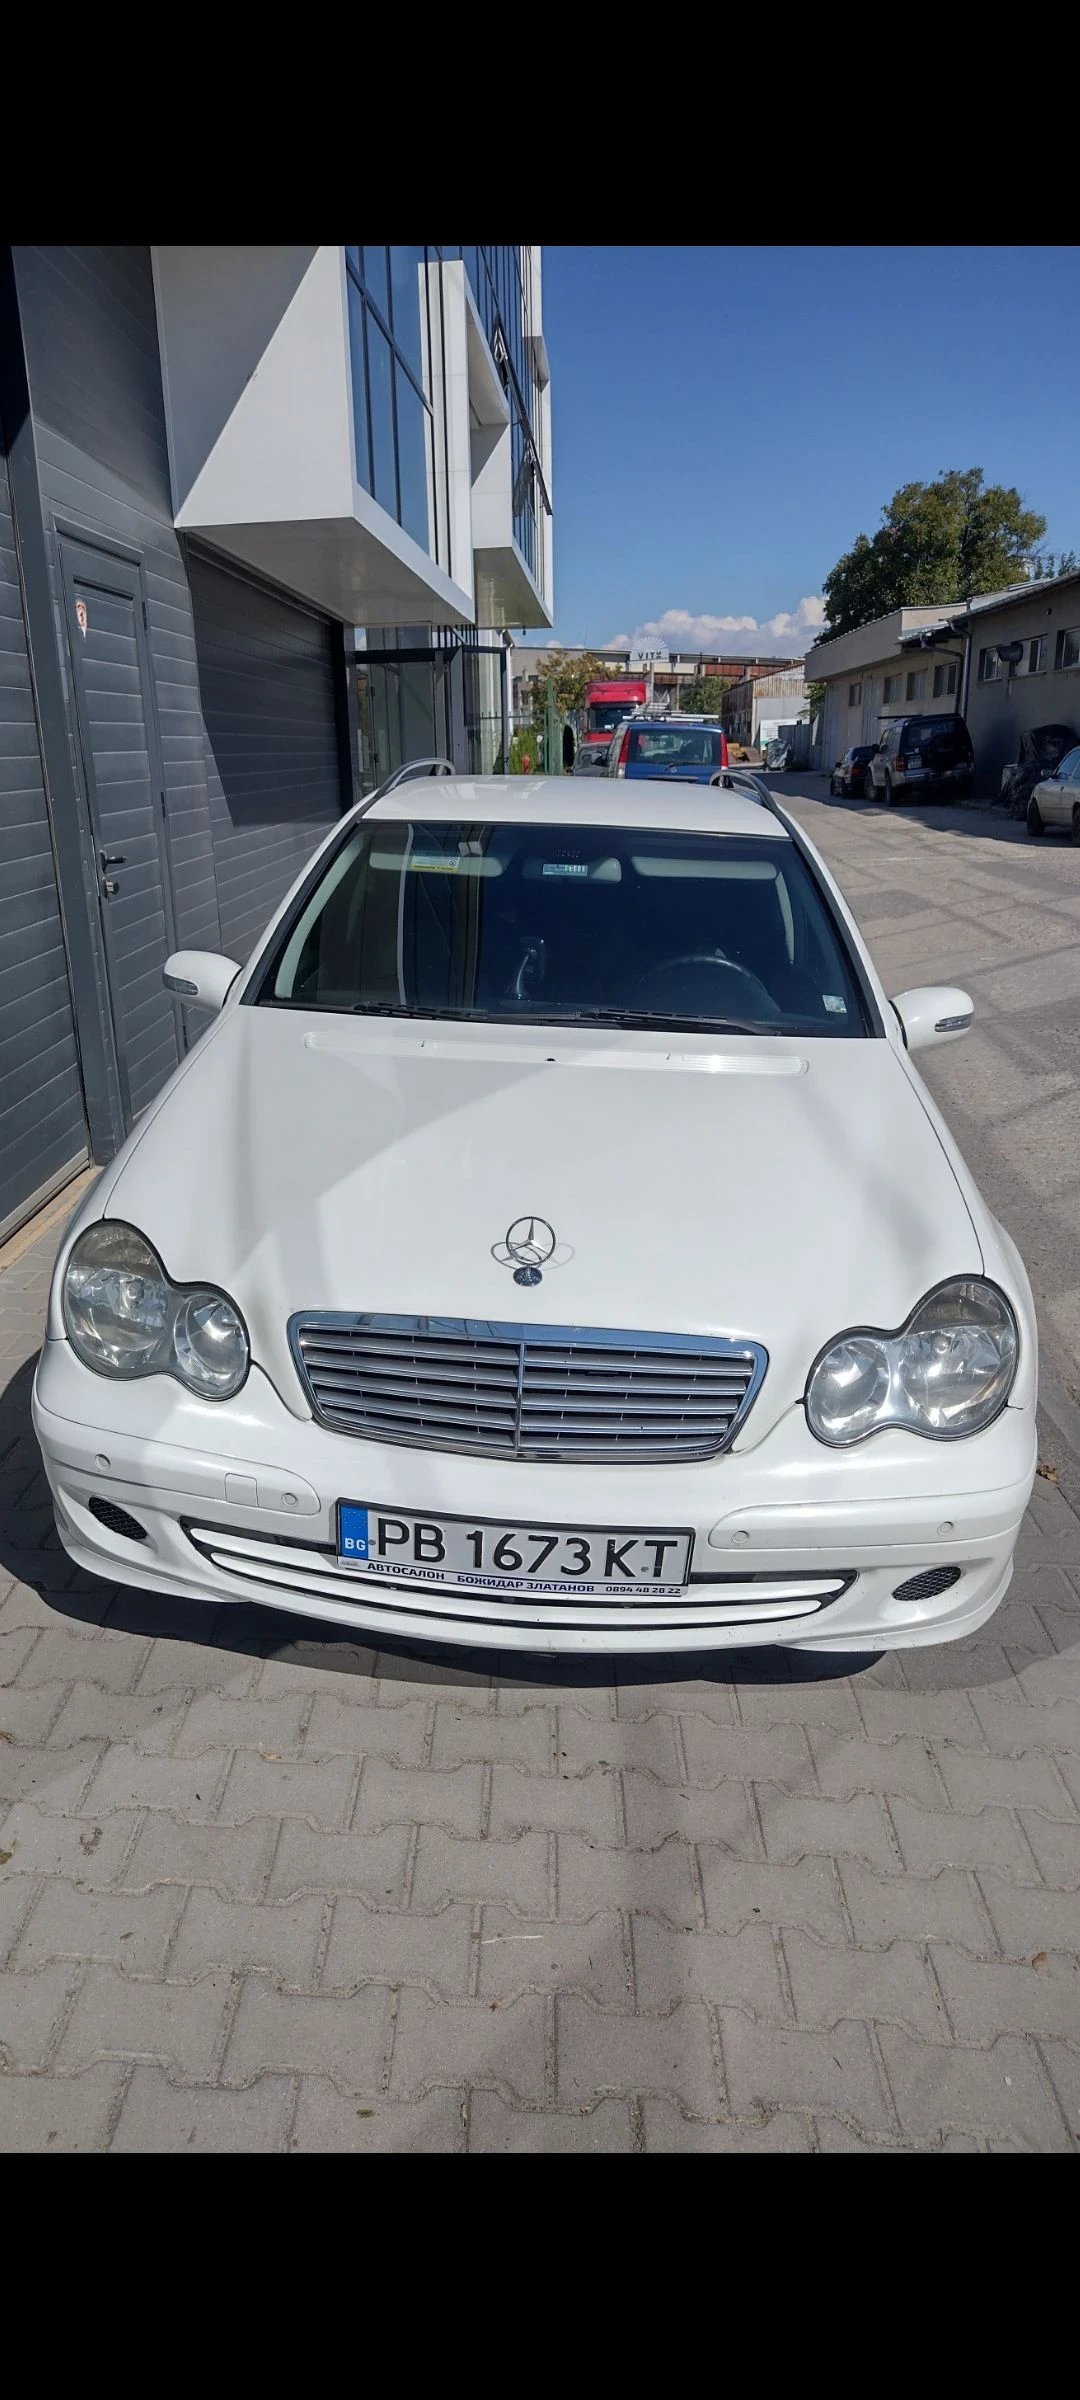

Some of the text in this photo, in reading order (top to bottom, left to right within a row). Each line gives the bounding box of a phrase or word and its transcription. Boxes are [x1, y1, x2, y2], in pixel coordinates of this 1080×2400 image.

[344, 1537, 366, 1551] BG
[377, 1517, 678, 1578] PB 1673 KT
[367, 1562, 445, 1580] АВТОСАЛОН
[457, 1575, 524, 1588] БОЖИДАР
[526, 1582, 595, 1592] ЗЛАТАНОВ
